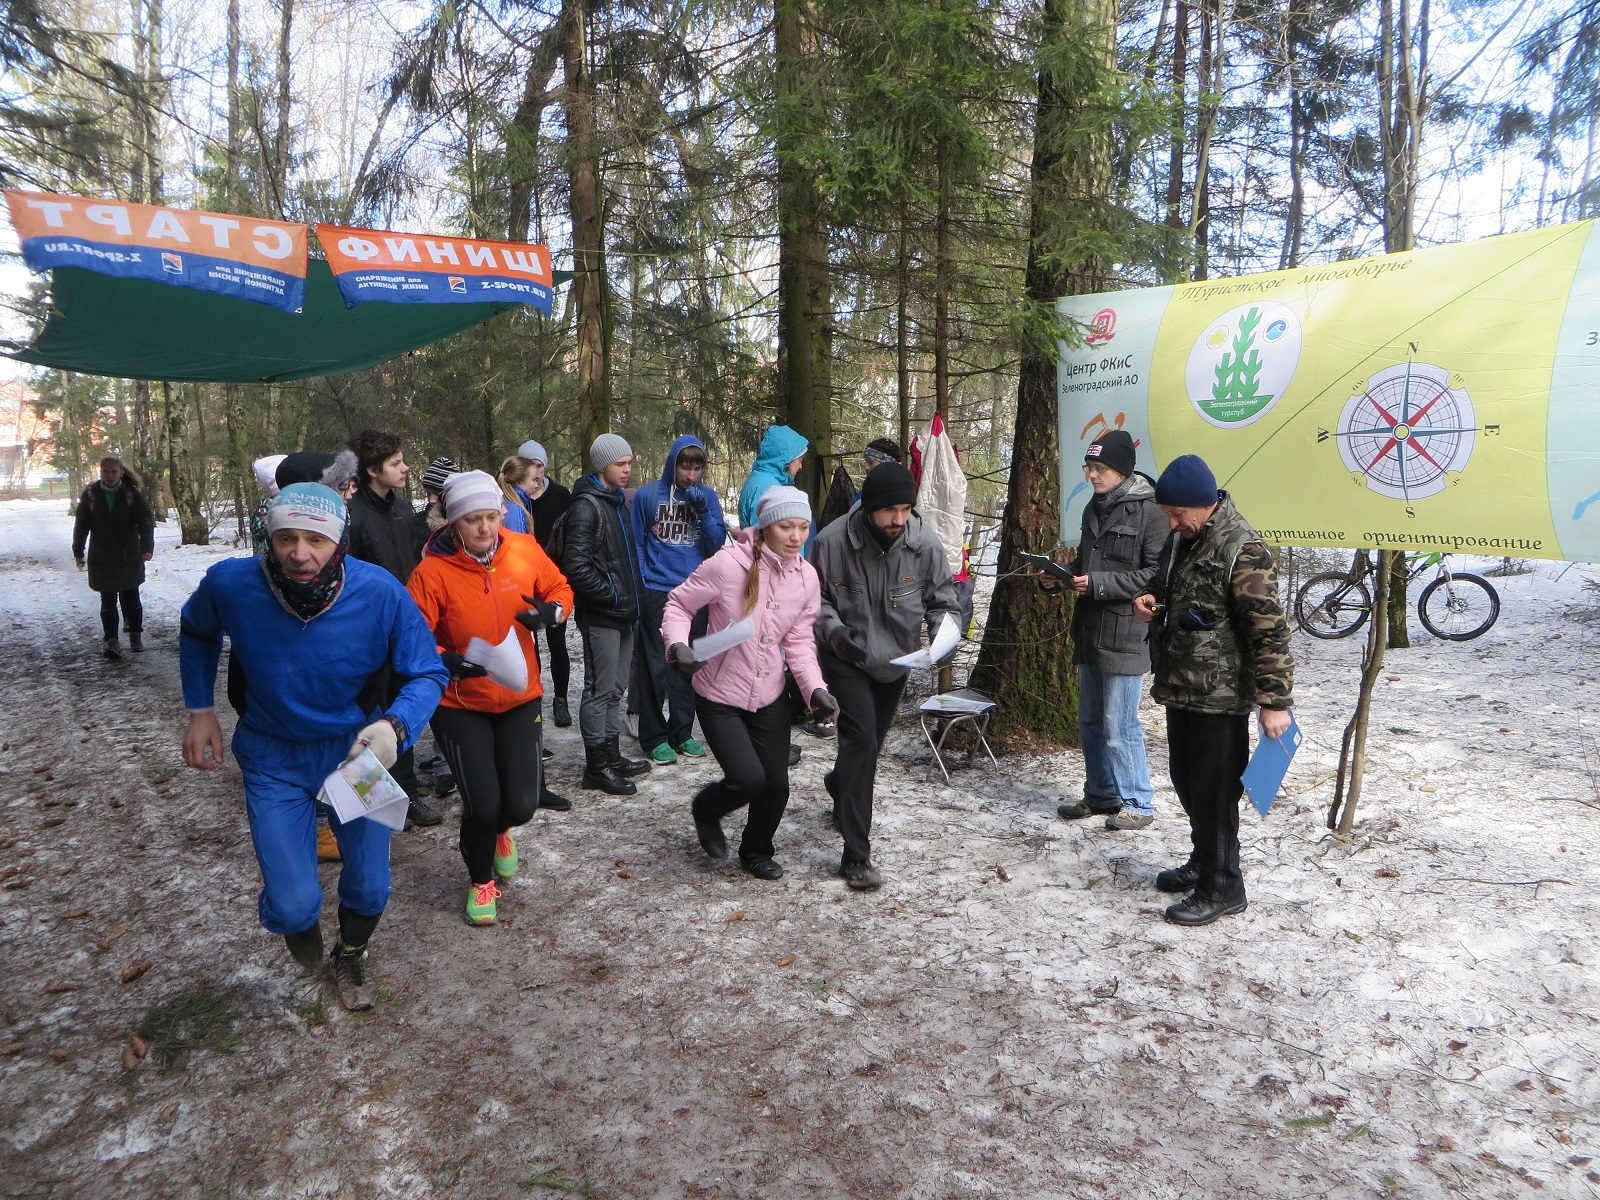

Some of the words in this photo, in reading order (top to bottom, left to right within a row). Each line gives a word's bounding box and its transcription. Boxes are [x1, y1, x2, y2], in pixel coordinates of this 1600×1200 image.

[337, 236, 544, 276] ФИНИШ
[355, 275, 406, 284] СНАРЯЖЕНИЕ
[358, 282, 398, 291] АКТИВНОЙ
[401, 283, 429, 291] ЖИЗНИ
[1179, 277, 1286, 302] Туристское
[1297, 255, 1413, 287] многоборье
[481, 281, 546, 299] Z-SPORT.RU
[1585, 330, 1600, 346] З
[1405, 341, 1420, 355] N
[1066, 361, 1097, 379] Центр
[1100, 354, 1133, 372] ФКиС
[1062, 376, 1122, 394] Зеленоградский
[1123, 374, 1139, 386] АО
[1317, 427, 1331, 444] W
[1484, 423, 1501, 436] E
[1405, 506, 1416, 519] S
[657, 522, 689, 542] UP!
[1252, 529, 1346, 543] портивное
[1362, 530, 1543, 551] ориентирование
